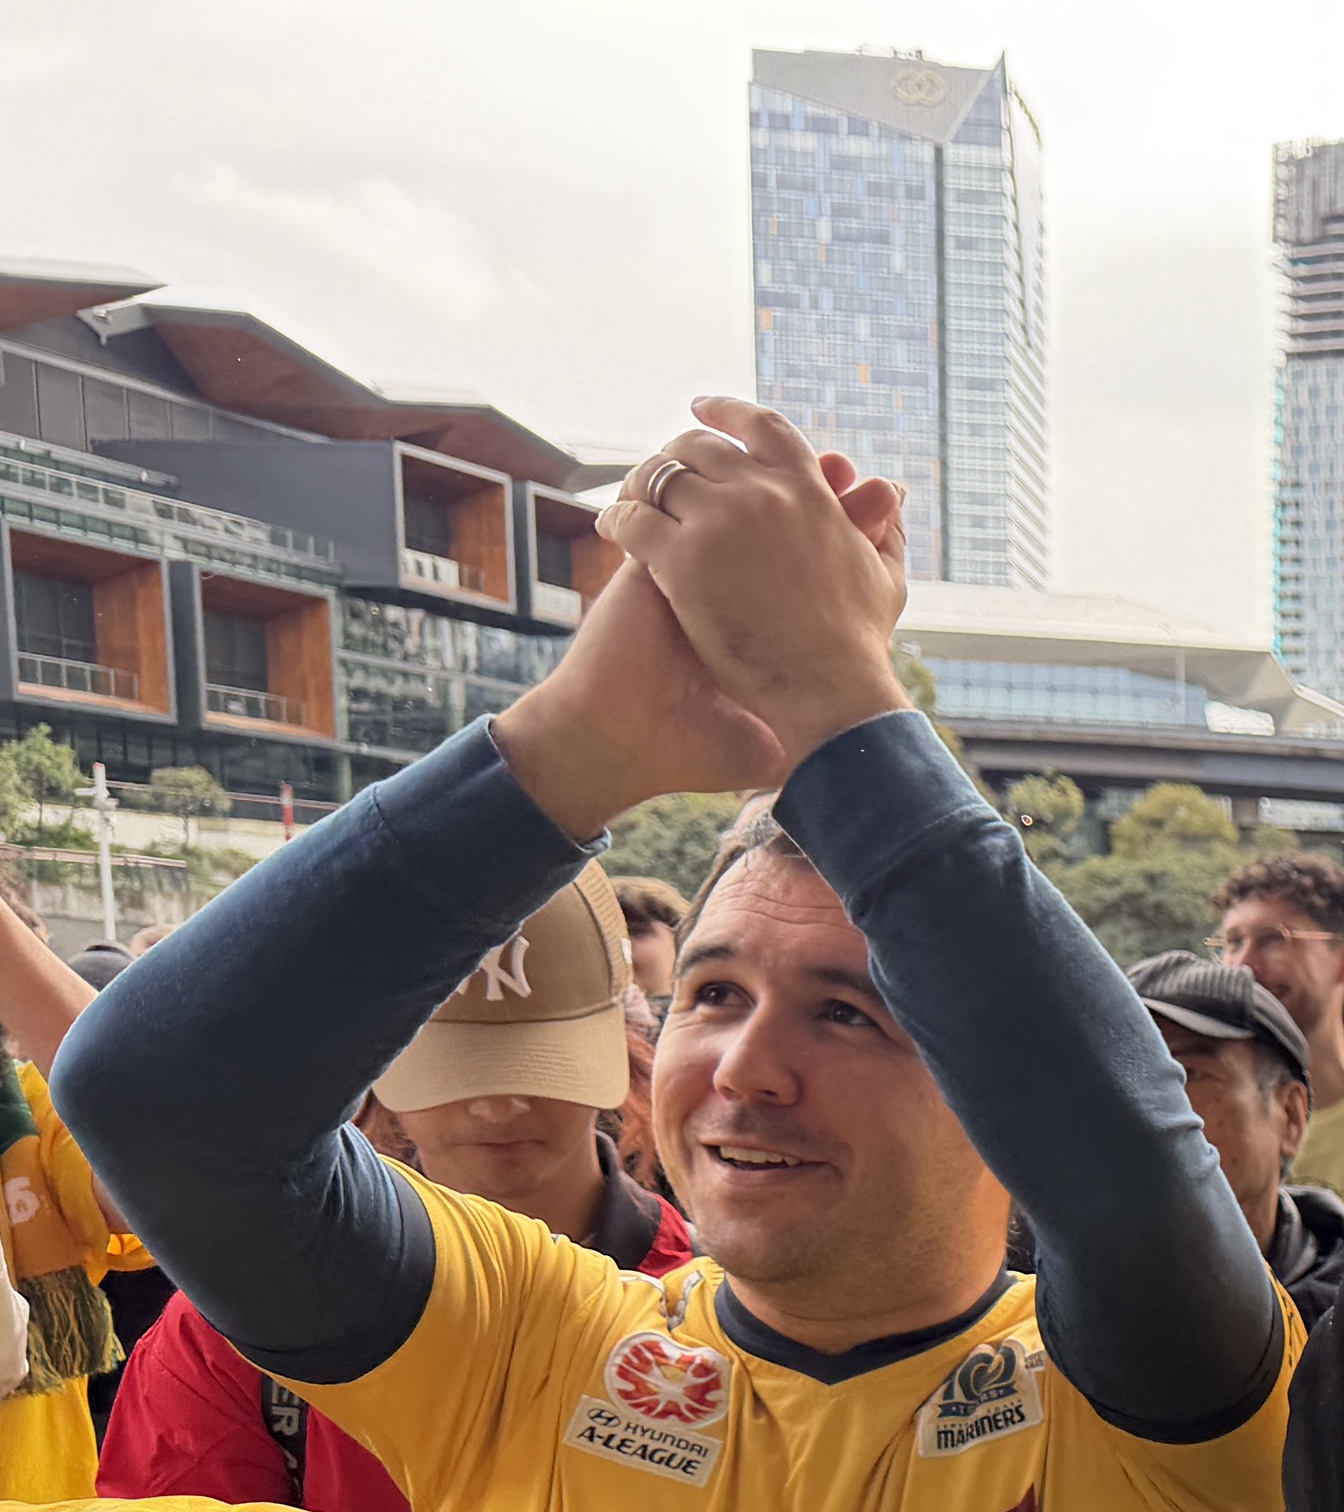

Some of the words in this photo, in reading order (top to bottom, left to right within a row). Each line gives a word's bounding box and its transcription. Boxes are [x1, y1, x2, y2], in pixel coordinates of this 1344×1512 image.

[624, 1420, 709, 1458] HYUNDAI
[937, 1403, 1026, 1450] MARINERS
[576, 1425, 702, 1476] A-LEAGUE
